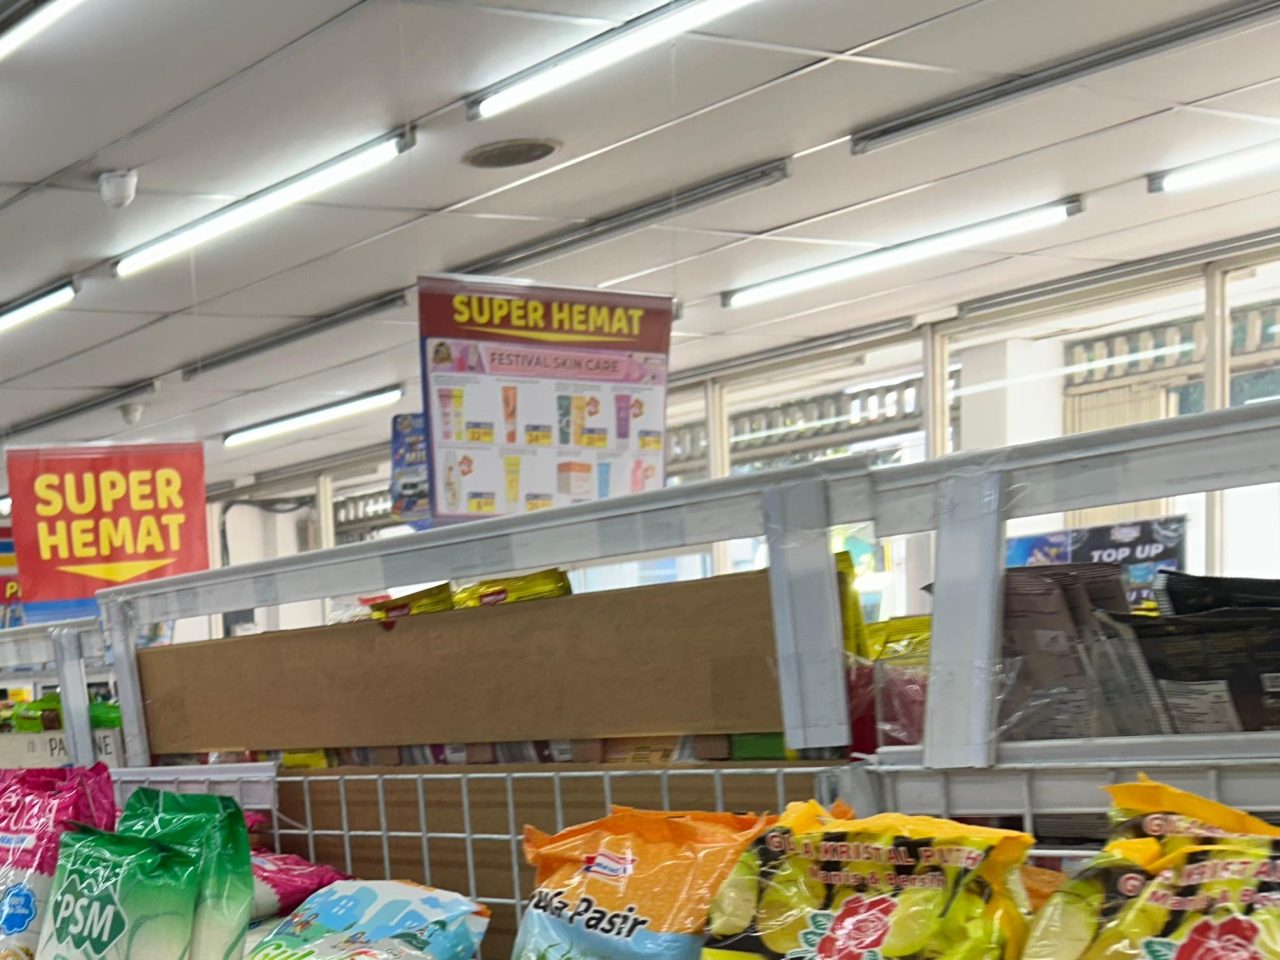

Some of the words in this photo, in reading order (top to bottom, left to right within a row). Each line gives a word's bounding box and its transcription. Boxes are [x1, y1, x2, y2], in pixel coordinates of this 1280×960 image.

[452, 294, 546, 329] SUPER
[551, 303, 644, 336] HEMAT
[490, 352, 551, 369] FESTIVAL
[586, 358, 618, 373] CARE
[33, 468, 184, 517] SUPER
[37, 513, 186, 560] HEMAT
[1091, 547, 1131, 563] TOP
[1134, 543, 1164, 559] UP
[821, 842, 916, 866] KRISTAL
[55, 893, 116, 943] PSM
[569, 896, 649, 939] Pasir
